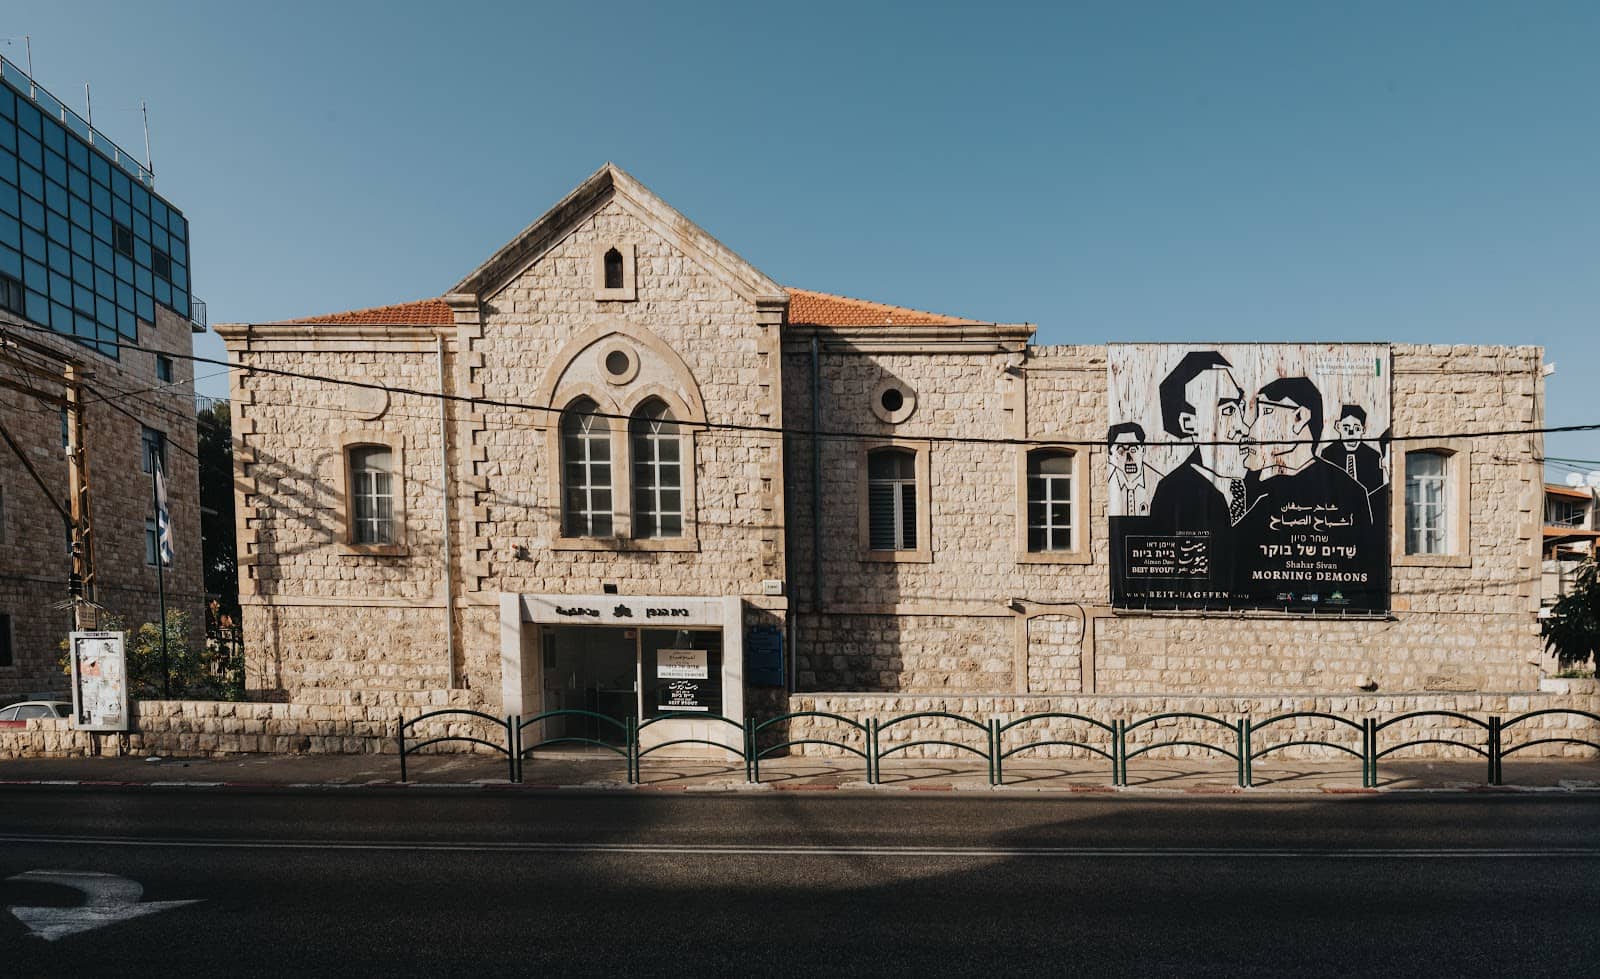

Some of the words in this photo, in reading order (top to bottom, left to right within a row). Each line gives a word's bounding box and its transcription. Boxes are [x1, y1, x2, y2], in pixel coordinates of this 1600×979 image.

[1269, 514, 1312, 531] الصباح
[1313, 513, 1354, 532] أشباح
[1291, 534, 1306, 544] סיון
[1310, 534, 1329, 543] שחר
[1132, 549, 1152, 558] ביות
[1155, 549, 1176, 558] ביית
[1259, 545, 1293, 558] בוקר
[1297, 544, 1316, 556] של
[1285, 560, 1315, 569] Shahar
[1316, 561, 1338, 570] Sivan
[1252, 570, 1313, 581] MORNING
[1316, 571, 1368, 582] DEMONS
